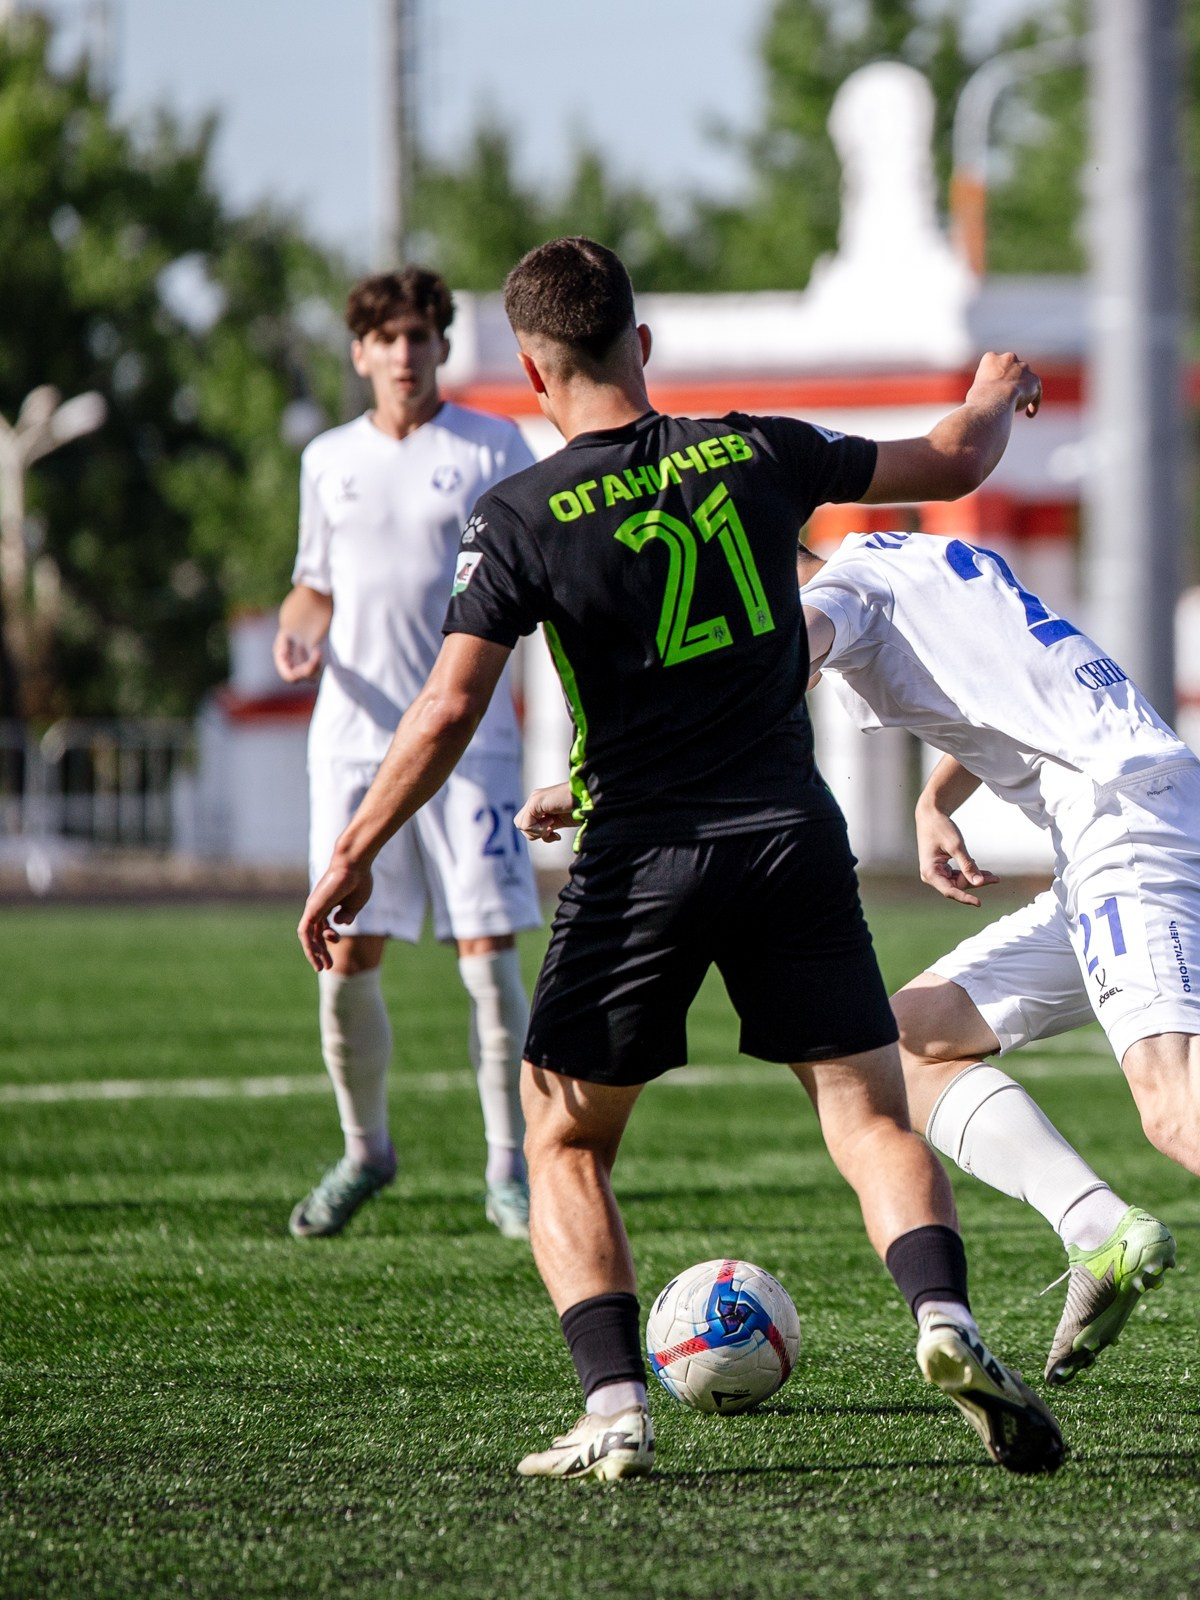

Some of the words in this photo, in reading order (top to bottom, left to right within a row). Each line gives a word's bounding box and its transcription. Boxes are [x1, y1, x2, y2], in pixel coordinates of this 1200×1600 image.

[548, 434, 753, 522] ОГАНИЧЕВ
[613, 481, 775, 667] 21
[1079, 896, 1127, 978] 21
[1168, 920, 1191, 993] ЧЕРТАНОВО
